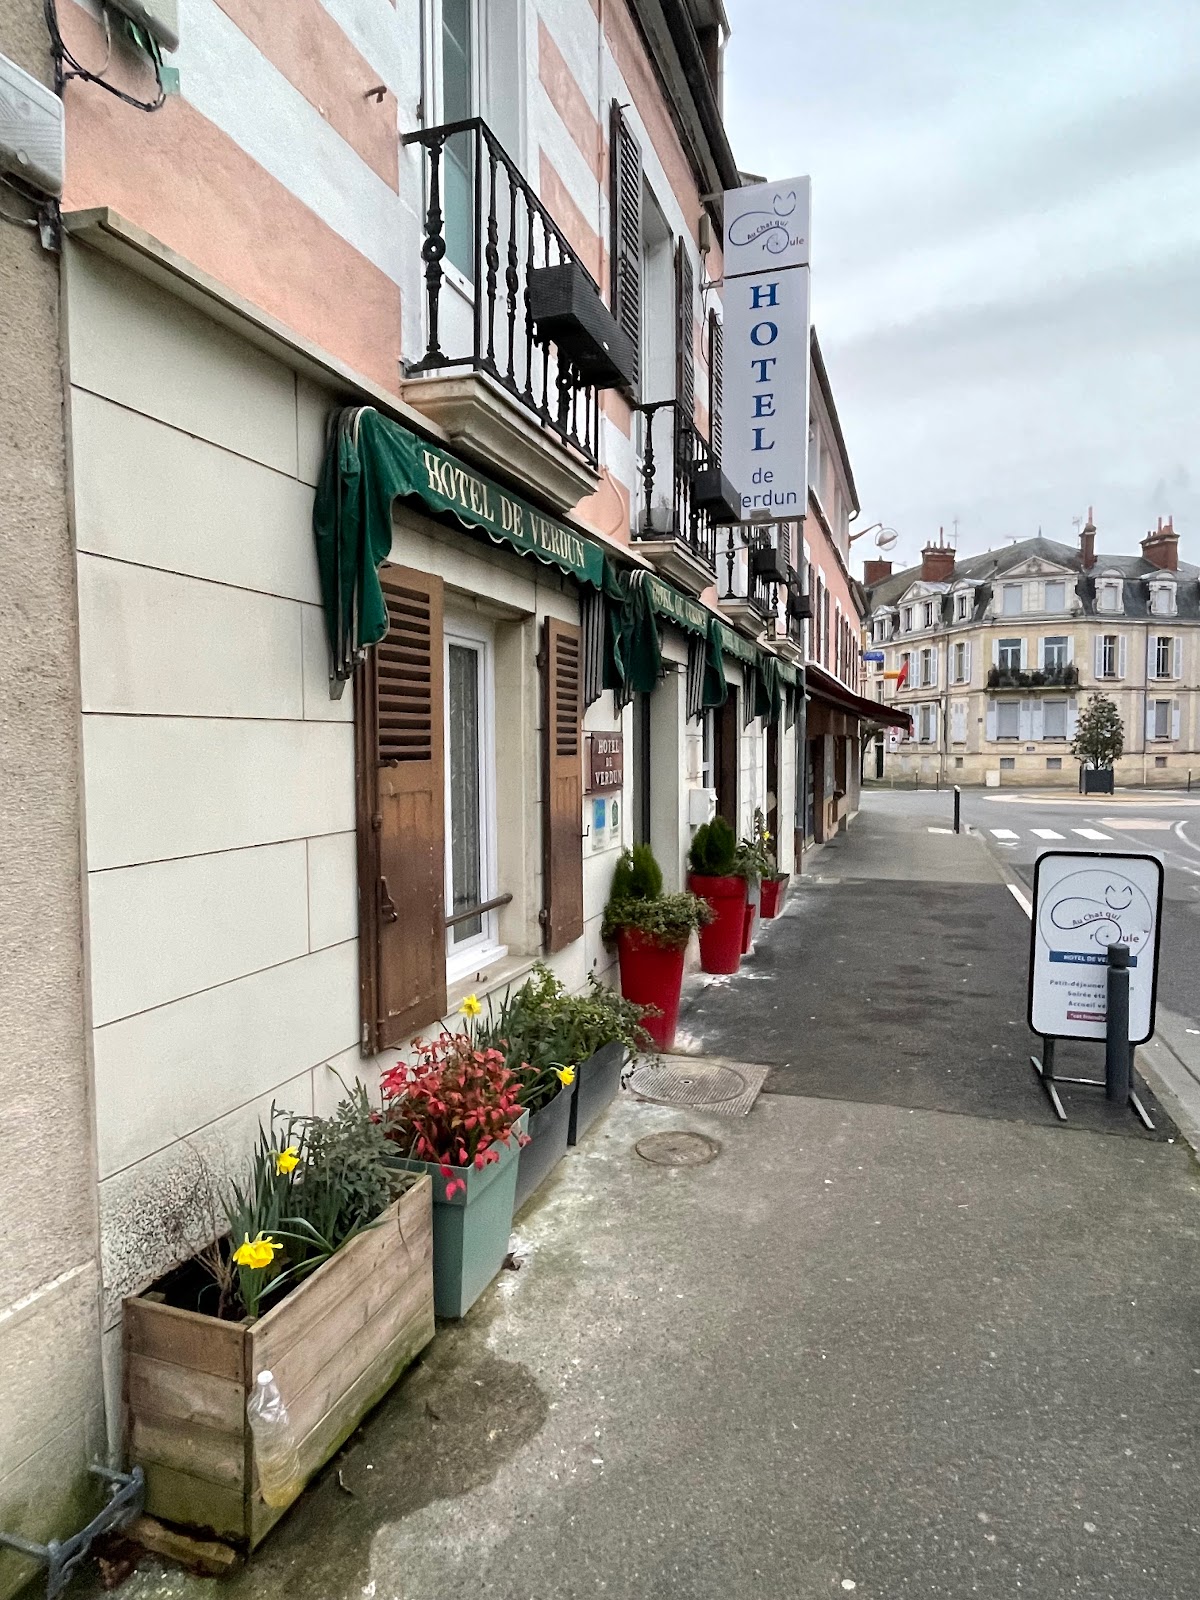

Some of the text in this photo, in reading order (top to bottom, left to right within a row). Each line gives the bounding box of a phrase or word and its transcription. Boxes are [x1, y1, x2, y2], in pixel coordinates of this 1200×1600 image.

[747, 220, 789, 240] Au Chat qui
[749, 282, 780, 451] HOTEL
[751, 467, 774, 485] de
[739, 489, 797, 508] erdun
[423, 449, 586, 568] HOTEL DE VERDUN
[597, 739, 620, 754] HOTEL
[595, 769, 622, 786] VERDUN
[1083, 911, 1104, 921] Chat
[1105, 911, 1122, 921] qui
[1063, 954, 1086, 962] HOTEL
[1049, 979, 1105, 989] Petit-déjeuner
[1067, 990, 1106, 999] Soirée éta
[1068, 1000, 1096, 1008] Accueil
